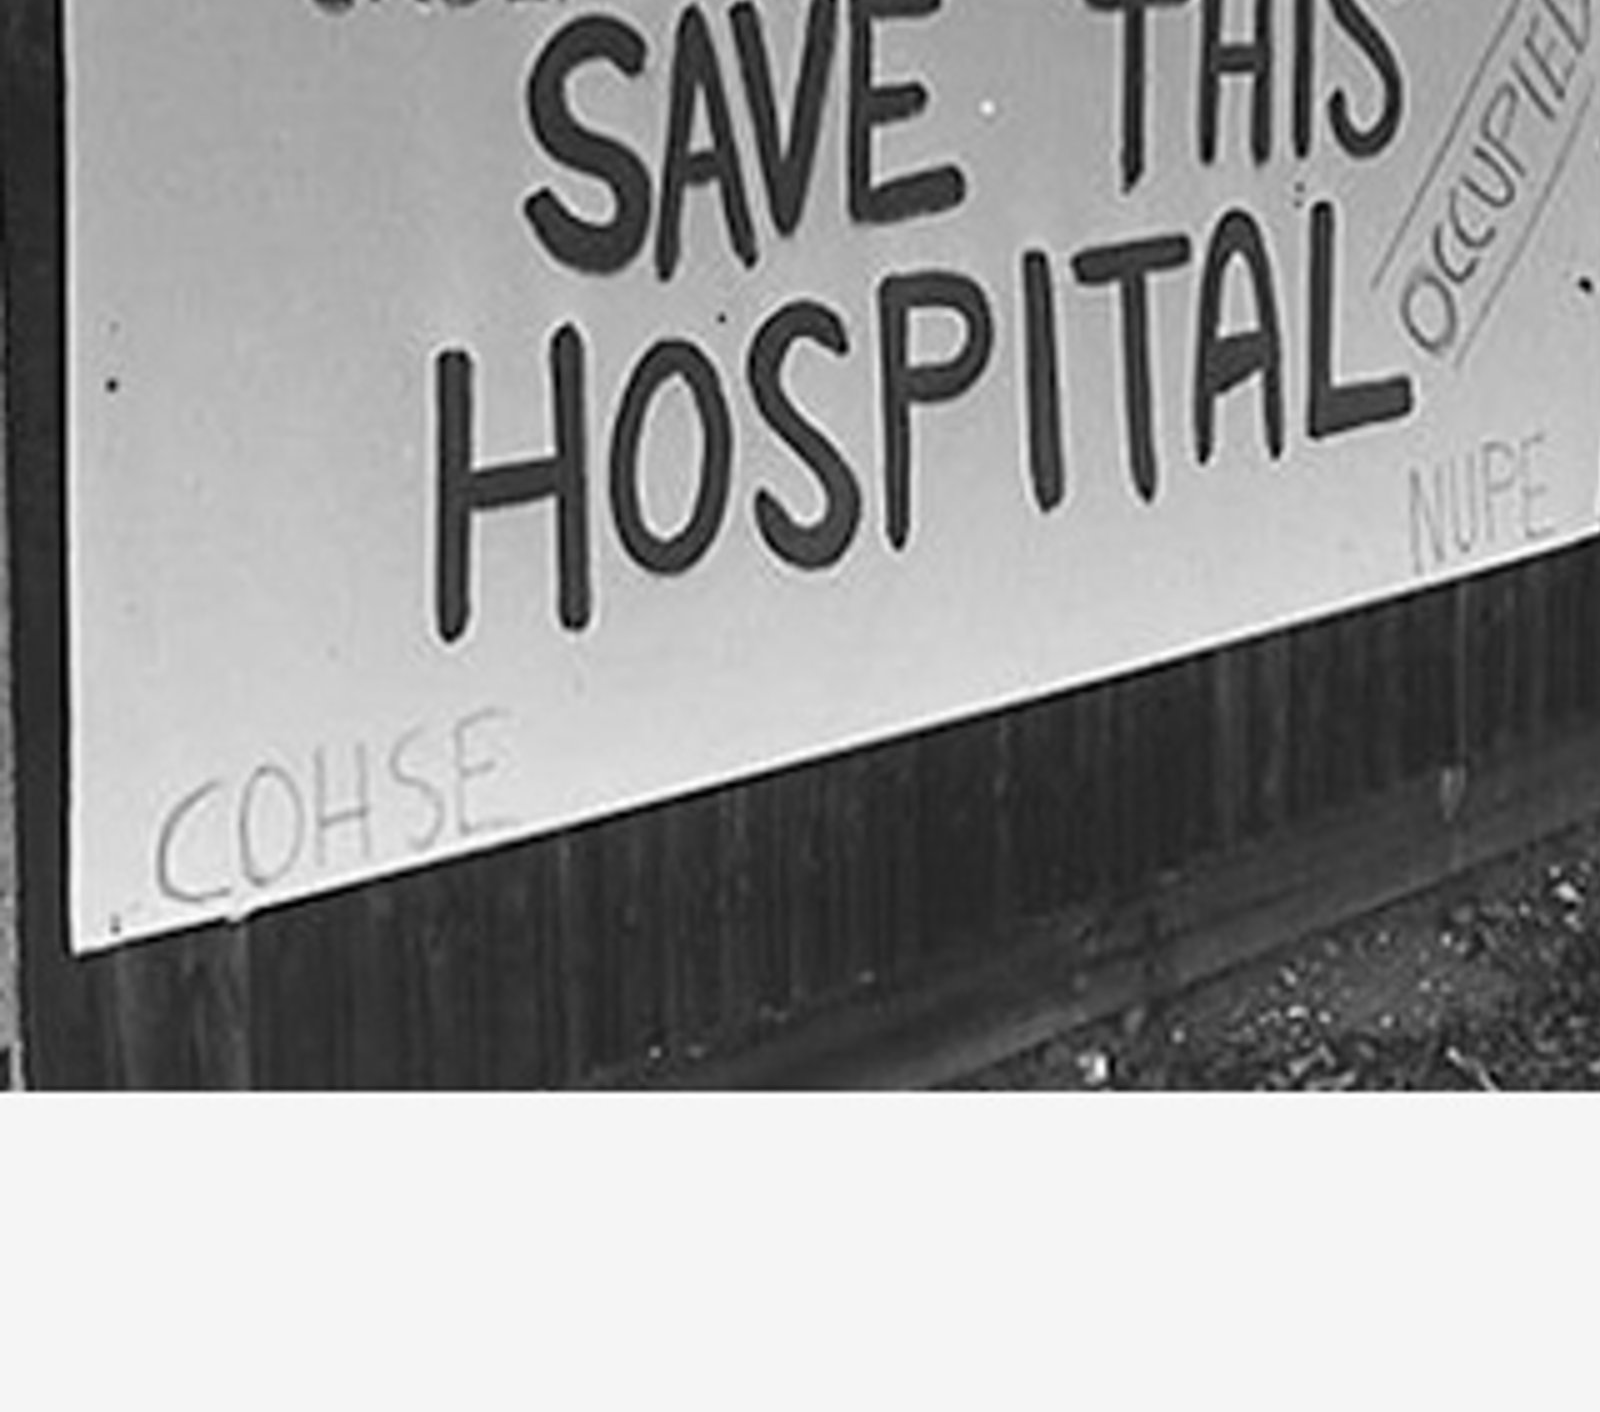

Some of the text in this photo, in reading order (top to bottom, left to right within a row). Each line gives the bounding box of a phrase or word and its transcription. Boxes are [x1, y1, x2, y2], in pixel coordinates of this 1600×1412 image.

[434, 199, 1415, 645] HOSPITAL
[1407, 432, 1550, 578] NUPE
[155, 706, 521, 906] COHSE
